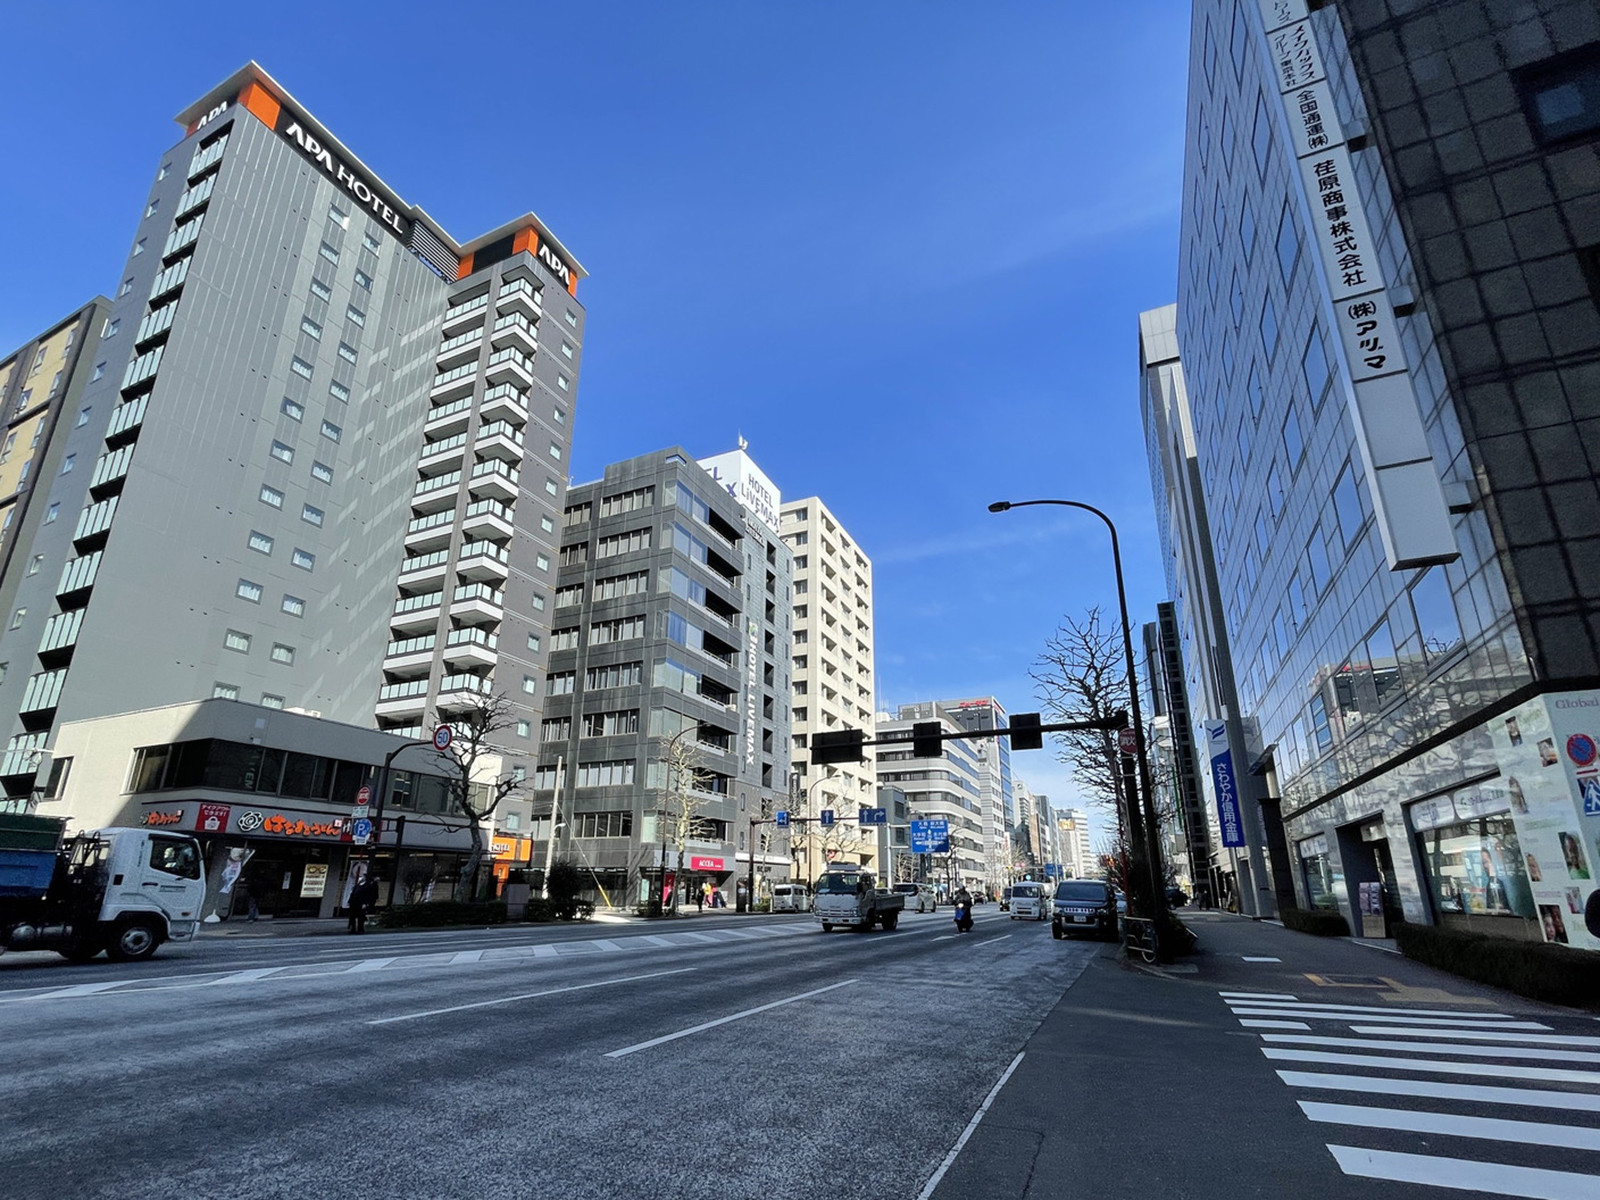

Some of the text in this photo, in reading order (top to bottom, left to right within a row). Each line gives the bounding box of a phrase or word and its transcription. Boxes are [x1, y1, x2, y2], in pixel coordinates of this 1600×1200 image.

[285, 122, 403, 234] APA HOTEL
[1313, 159, 1367, 287] 荏原商事株式会社
[538, 243, 570, 286] APA
[748, 472, 774, 509] HOTEL
[748, 643, 758, 688] HOTEL
[1554, 695, 1600, 709] Global
[437, 732, 448, 744] 50
[1216, 763, 1239, 842] さわやか信用金庫
